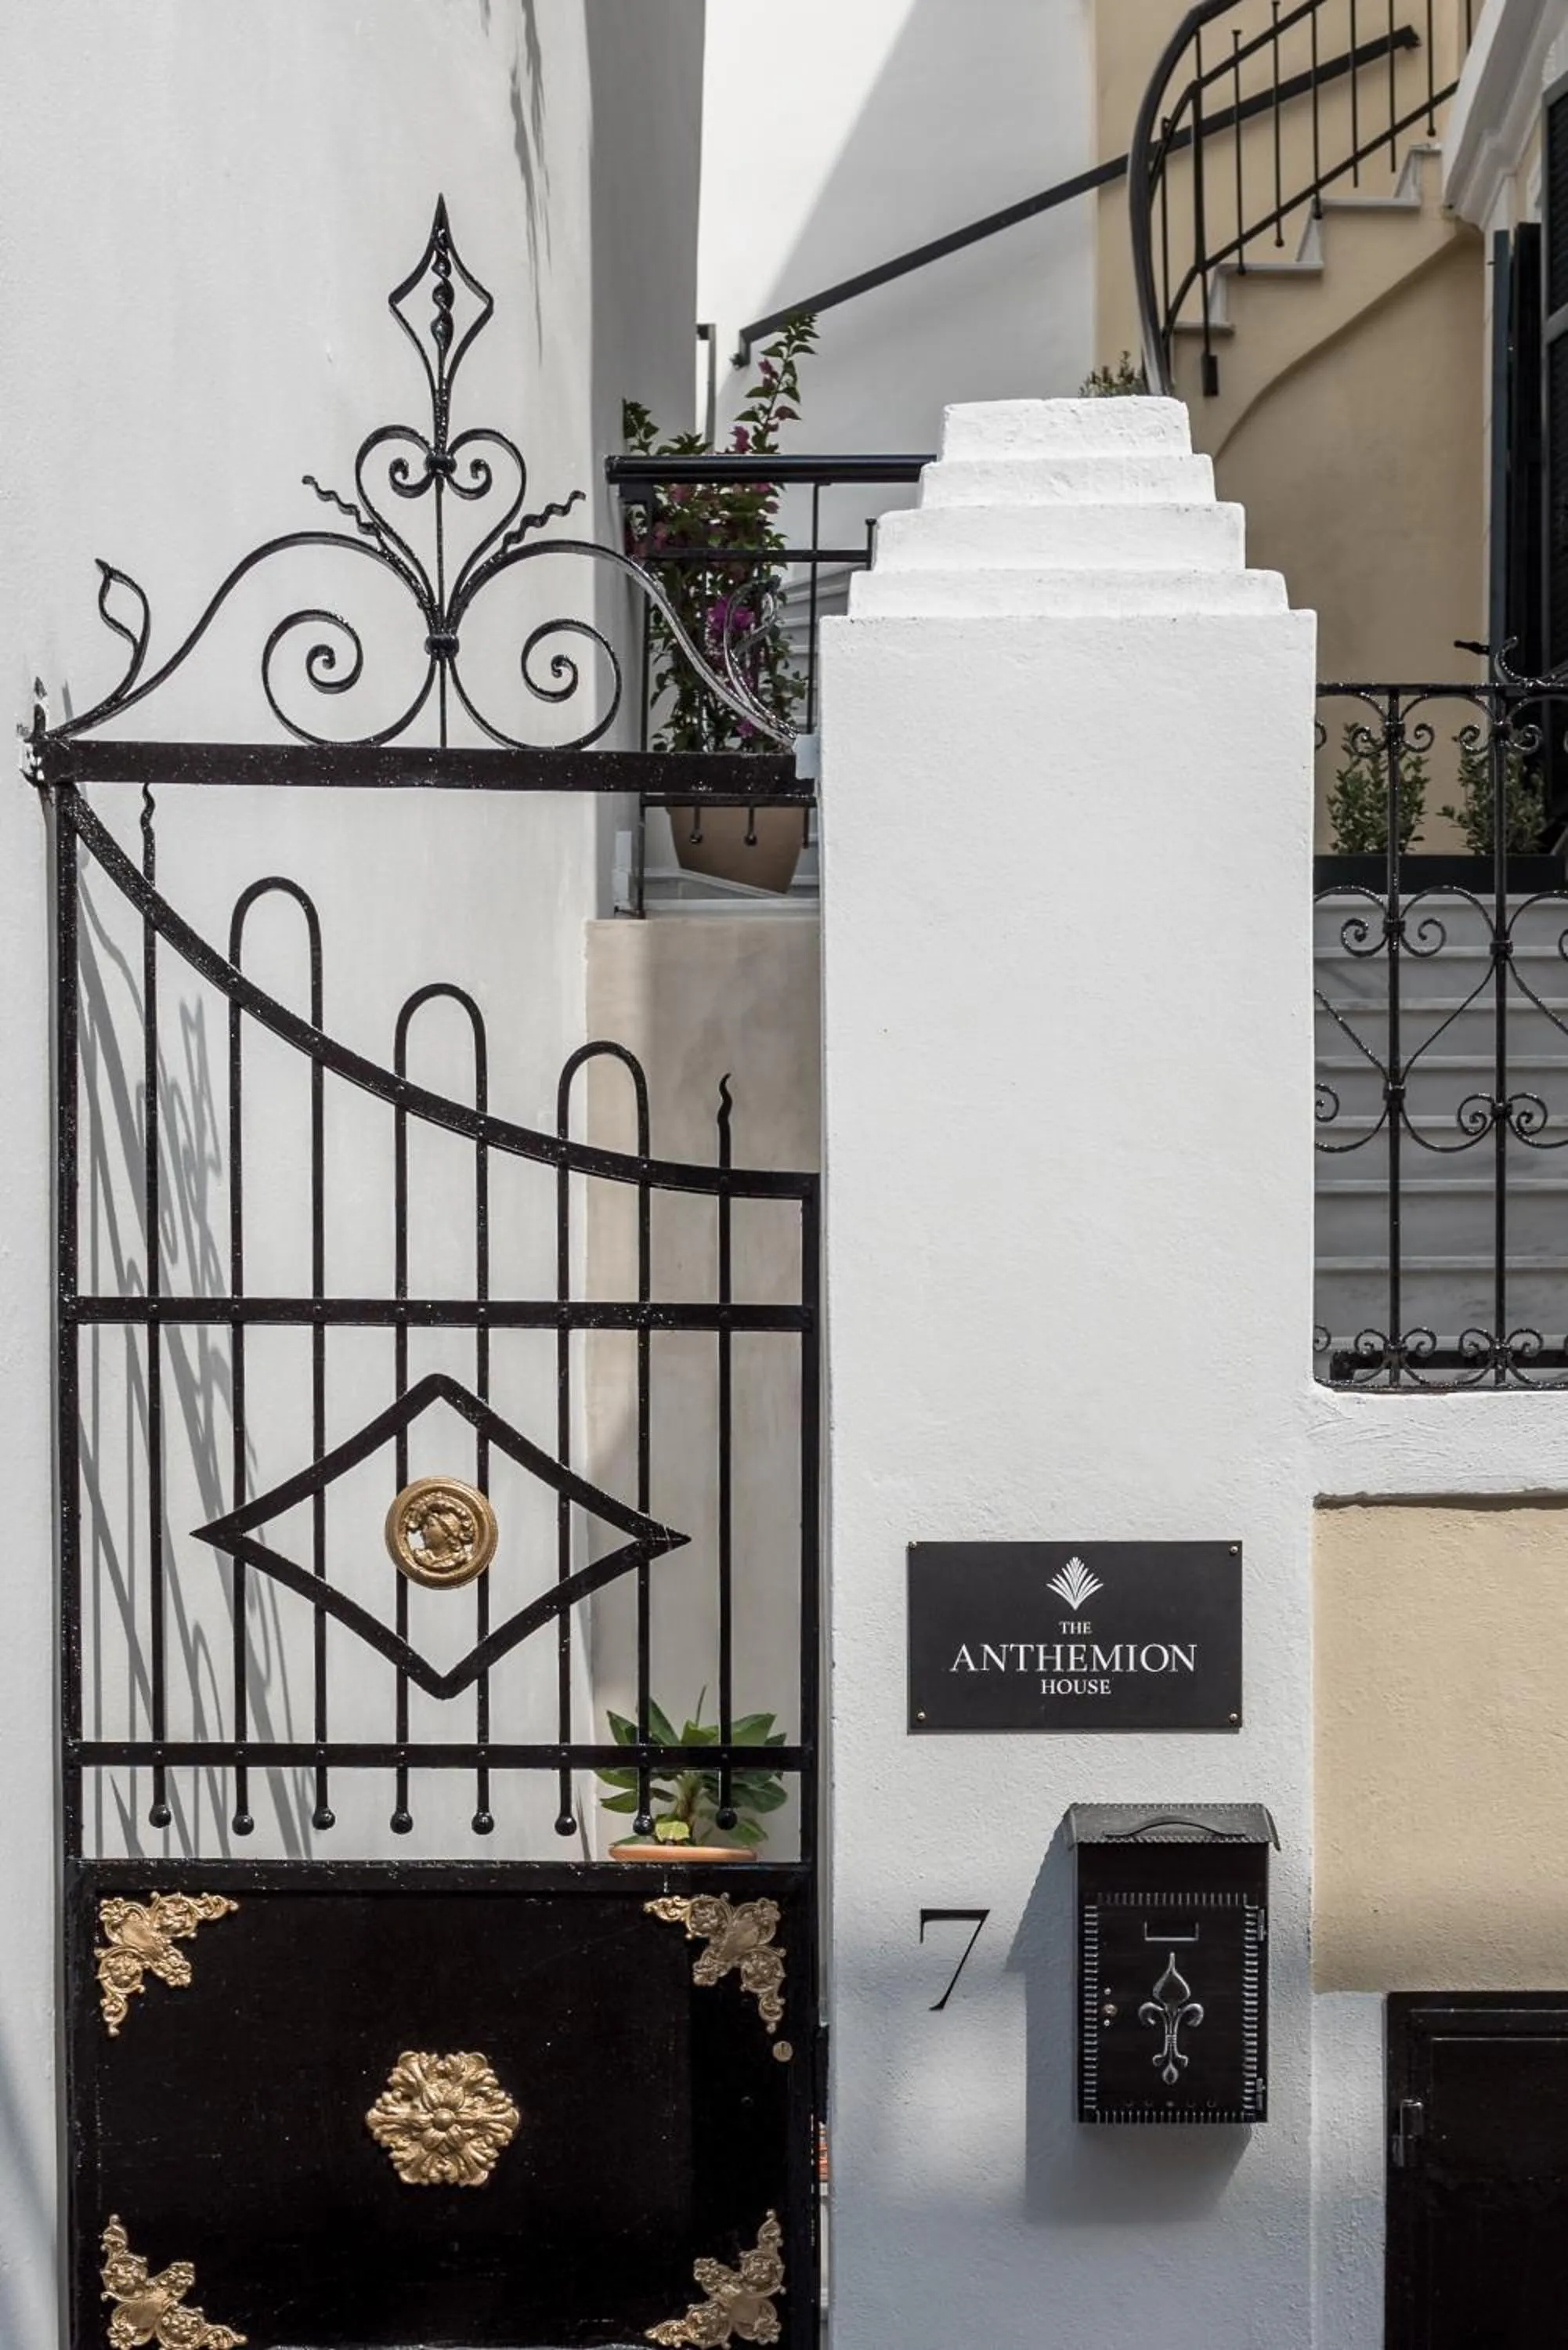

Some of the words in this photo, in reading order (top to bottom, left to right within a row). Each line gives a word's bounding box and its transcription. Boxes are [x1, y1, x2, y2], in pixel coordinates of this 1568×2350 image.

[1059, 1621, 1092, 1635] THE
[949, 1643, 1198, 1672] ANTHEMION
[1040, 1679, 1112, 1695] HOUSE
[919, 1908, 991, 2012] 7
